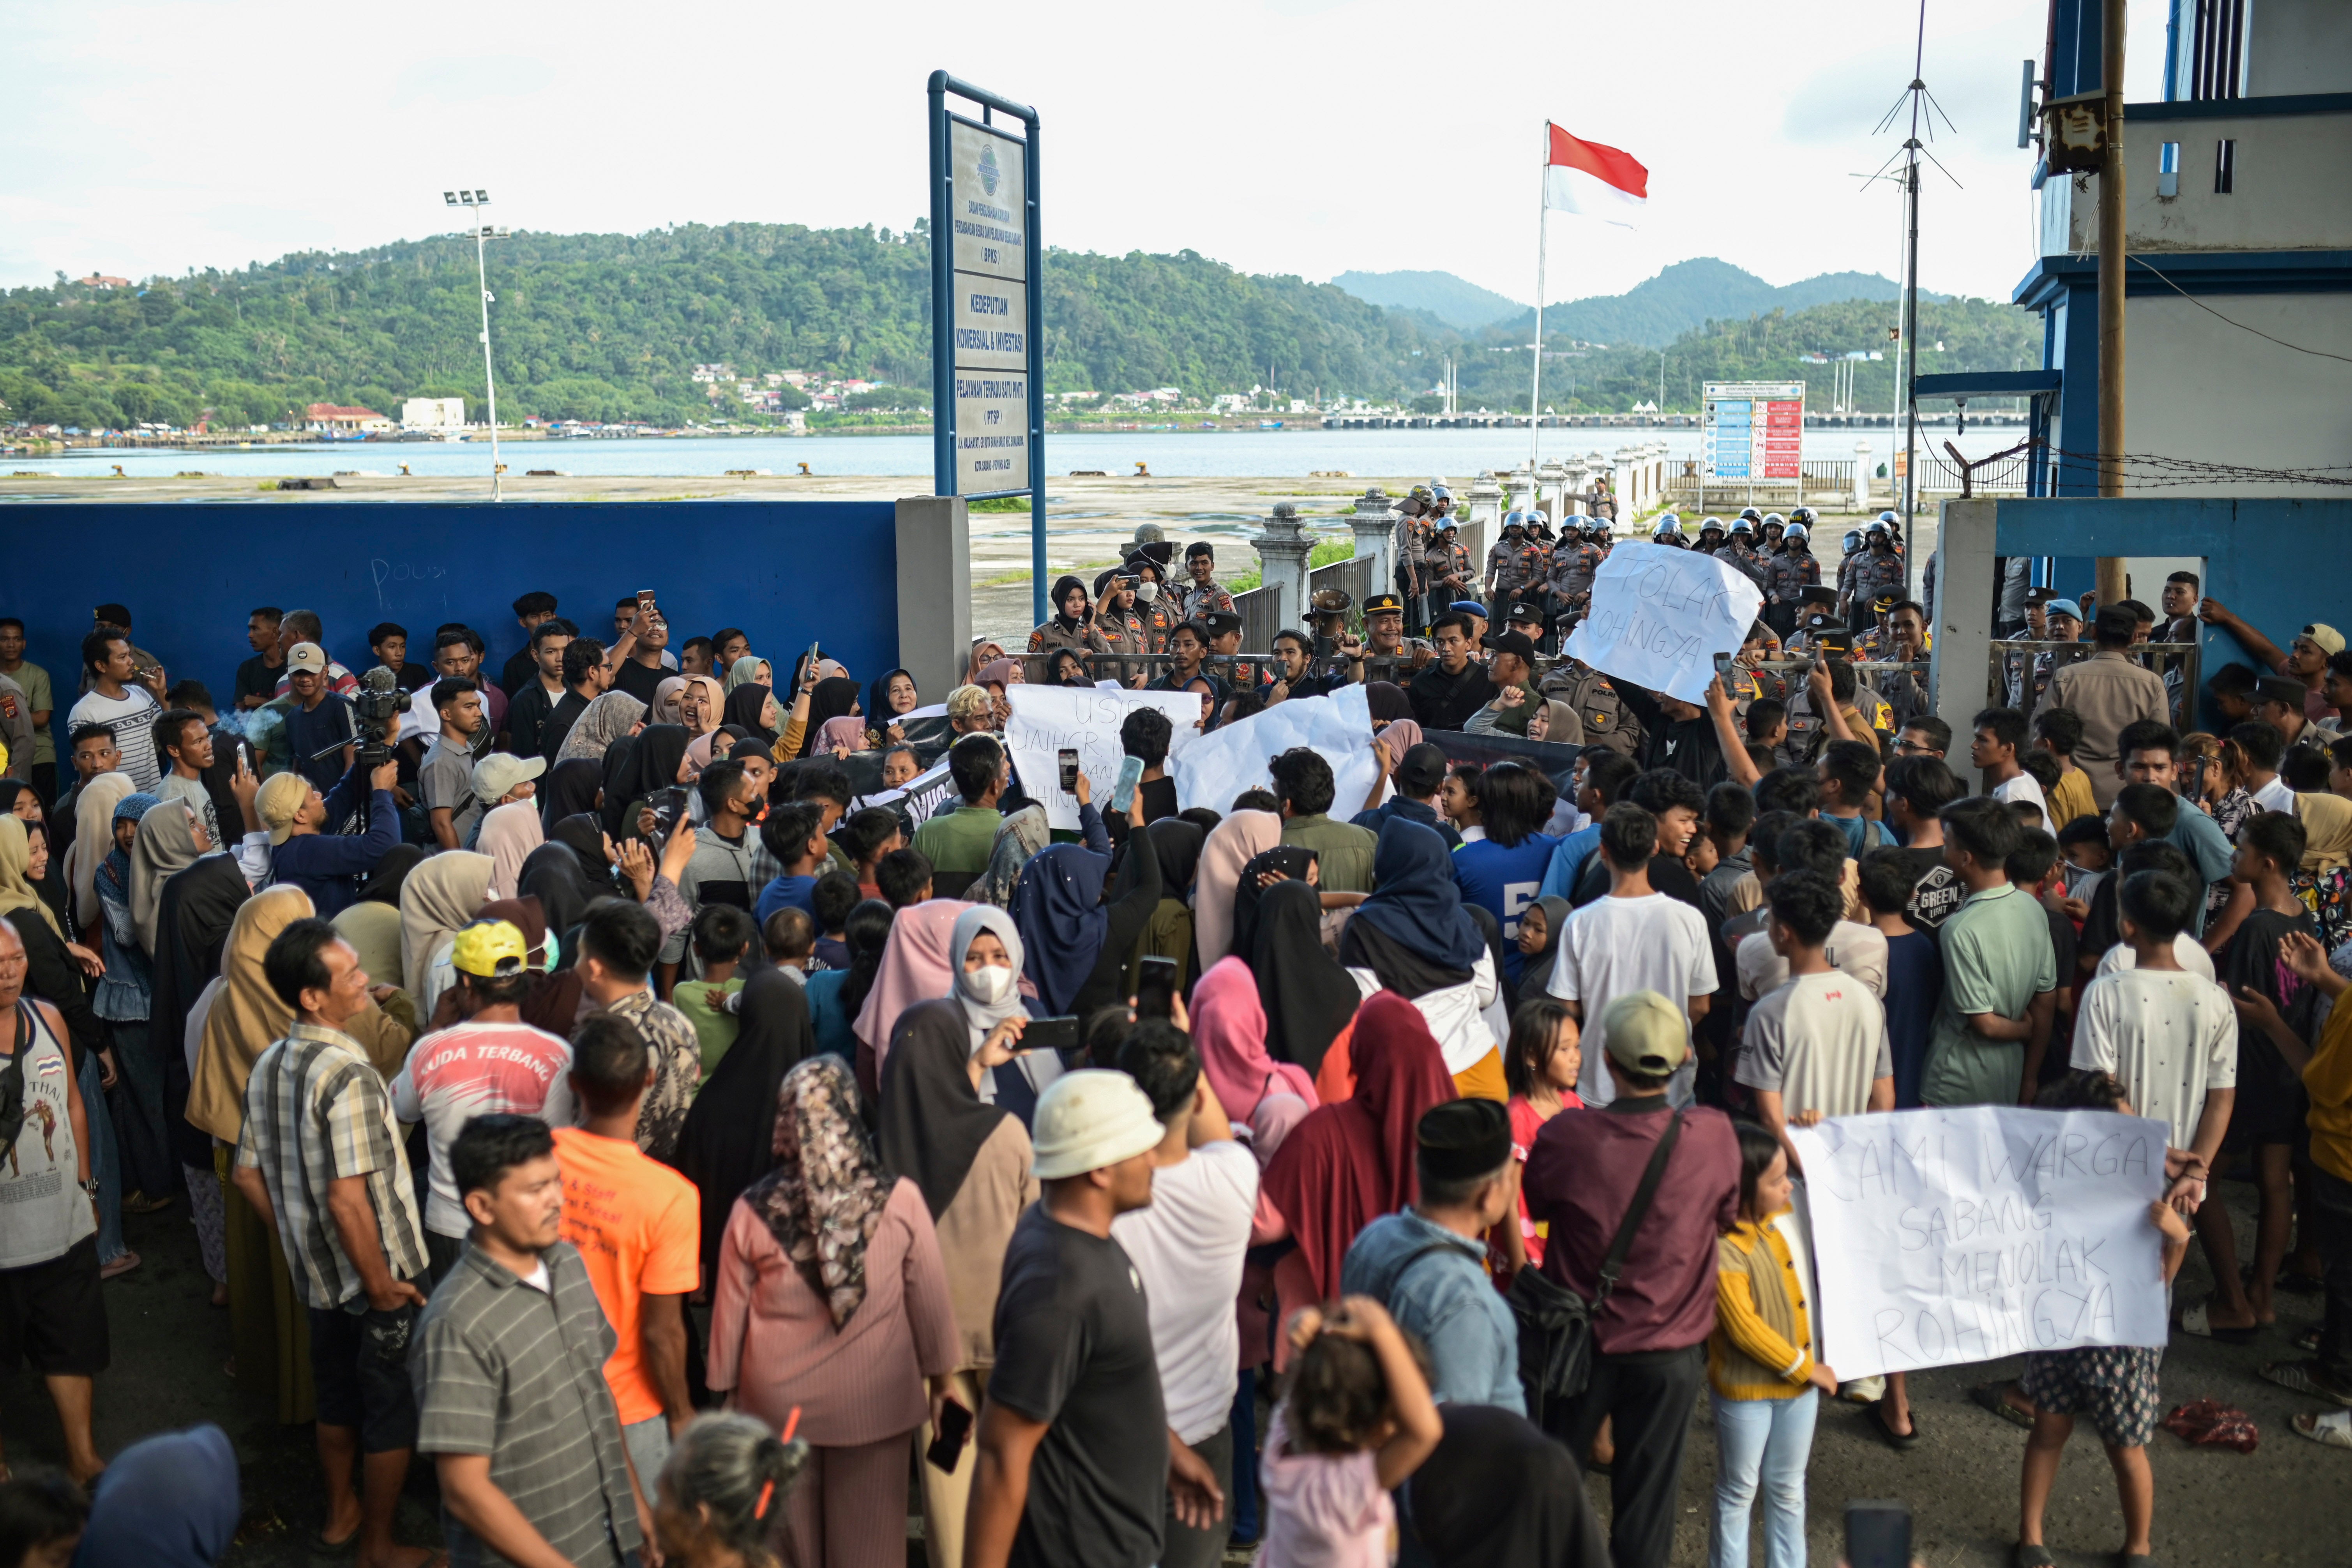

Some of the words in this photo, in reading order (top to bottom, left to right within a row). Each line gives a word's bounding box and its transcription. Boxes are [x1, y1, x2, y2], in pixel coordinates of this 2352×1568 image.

[968, 200, 978, 215] BADAN
[978, 203, 998, 220] PENGUSAHAAN
[955, 219, 975, 237] PERDAGANGAN
[976, 224, 984, 238] BEBAS
[990, 227, 1004, 242] PELABUHAN
[971, 294, 1008, 316] KEDEPUTIAN
[956, 328, 989, 350] KOMERSIAL
[991, 331, 995, 351] &
[996, 332, 1023, 353] INVESTASI
[957, 380, 982, 398] PELAYANAN
[983, 380, 1001, 399] TERPADU
[1002, 381, 1012, 398] SATU
[1013, 381, 1024, 399] PINTU
[982, 460, 991, 471] SABANG
[1622, 558, 1740, 625] TOLAK
[1592, 689, 1616, 698] POLRI
[1921, 886, 1958, 908] GREEN
[1504, 881, 1540, 941] 5
[1930, 905, 1948, 918] LIGHT
[29, 1081, 60, 1102] THAI
[1985, 1133, 2149, 1183] WARGA
[1900, 1192, 2052, 1251] SABANG
[1940, 1236, 2110, 1299] MENOLAK
[1875, 1283, 2115, 1373] ROHINGYA
